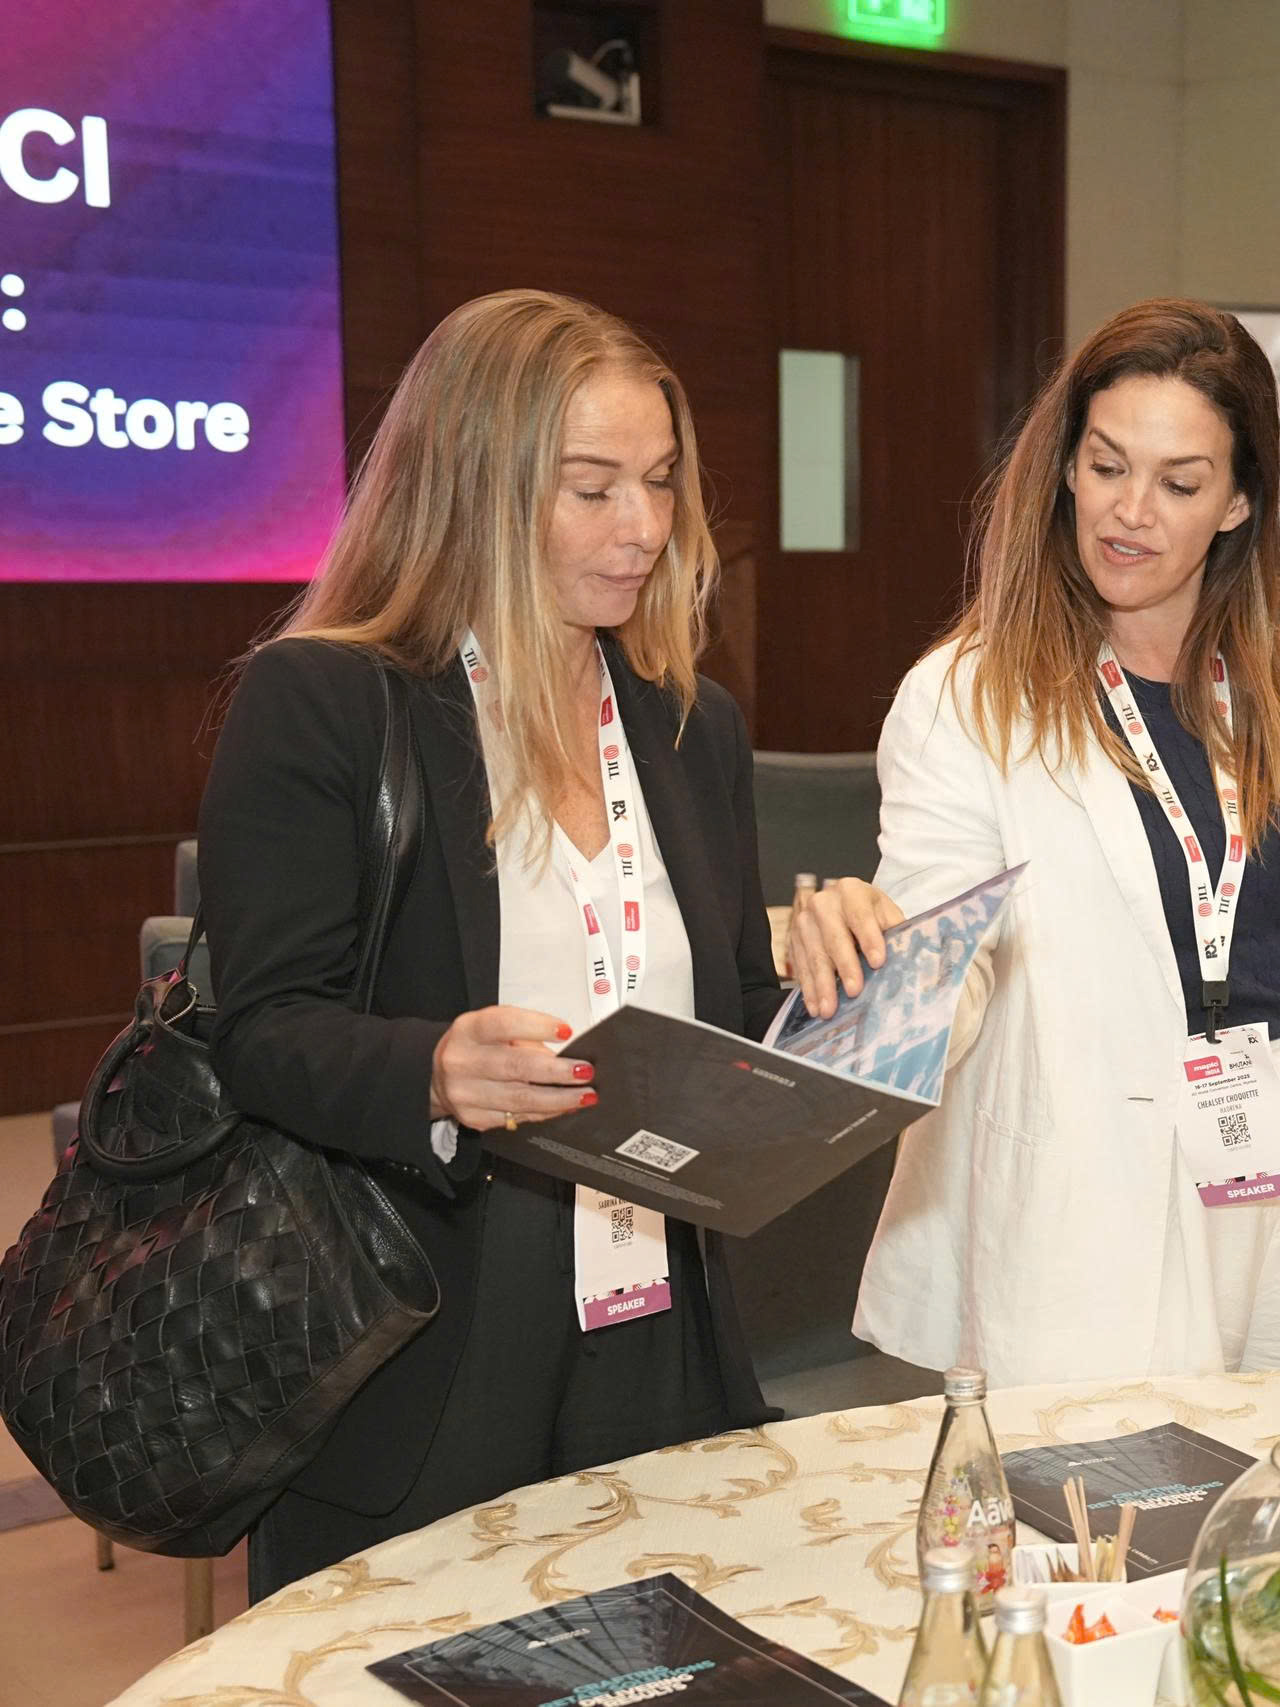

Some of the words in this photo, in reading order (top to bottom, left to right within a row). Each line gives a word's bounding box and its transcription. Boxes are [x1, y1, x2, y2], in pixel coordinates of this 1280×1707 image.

[42, 381, 250, 453] Store
[1122, 704, 1137, 722] JLL
[607, 761, 620, 780] JLL
[1162, 787, 1177, 805] JLL
[611, 800, 628, 821] RX
[1226, 801, 1238, 815] JLL
[622, 860, 633, 878] JLL
[1198, 883, 1208, 901] JLL
[1218, 900, 1230, 915] JLL
[1204, 938, 1218, 959] RX
[594, 957, 607, 977] JLL
[627, 972, 637, 993] JLL
[1208, 1077, 1236, 1088] September
[1197, 1096, 1225, 1110] CHEALSEY
[1226, 1089, 1259, 1103] CHOQUETTE
[1226, 1183, 1276, 1199] SPEAKER
[607, 1297, 646, 1316] SPEAKER
